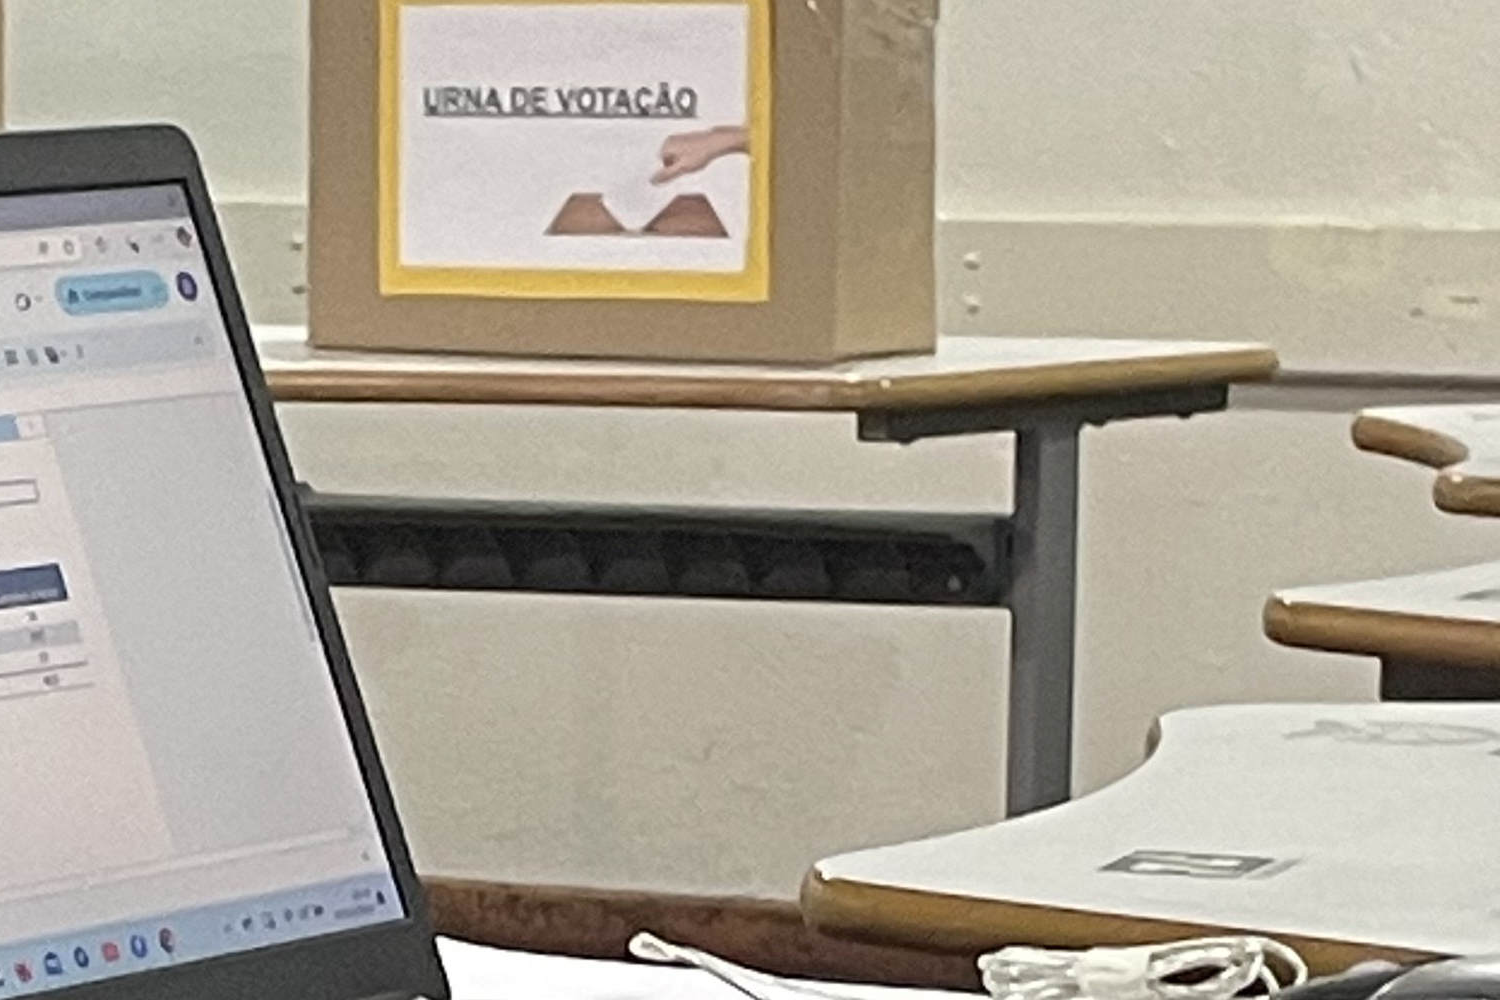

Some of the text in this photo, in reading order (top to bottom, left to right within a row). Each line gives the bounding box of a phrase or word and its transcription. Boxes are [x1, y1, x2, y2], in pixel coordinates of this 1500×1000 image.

[423, 82, 698, 118] URNA DE VOTAÇÃO
